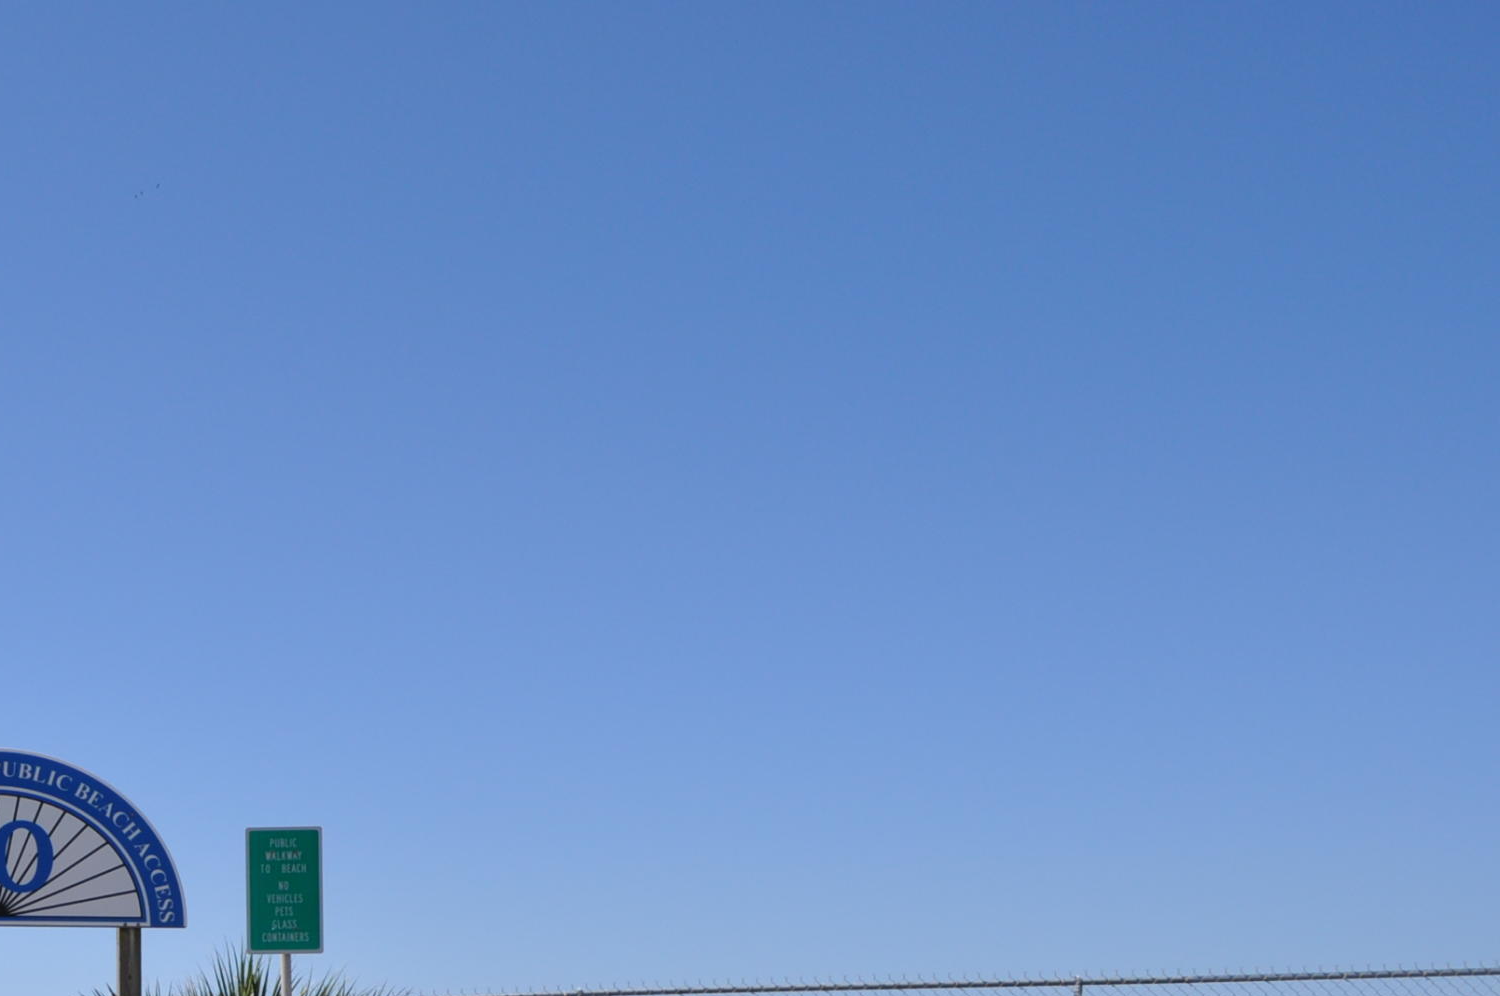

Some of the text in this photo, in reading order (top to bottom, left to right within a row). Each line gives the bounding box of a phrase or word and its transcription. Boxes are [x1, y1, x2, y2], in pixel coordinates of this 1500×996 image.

[270, 838, 297, 848] PUBLIC
[74, 782, 141, 841] BEACH
[134, 843, 176, 924] ACCESS
[265, 850, 302, 860] WALKWAY
[260, 864, 307, 874] TO BEACH
[278, 881, 289, 890] NO
[266, 894, 304, 904] VEHICLES
[275, 906, 293, 916] PETS
[272, 920, 298, 929] GLASS
[262, 932, 309, 942] CONTAINERS
